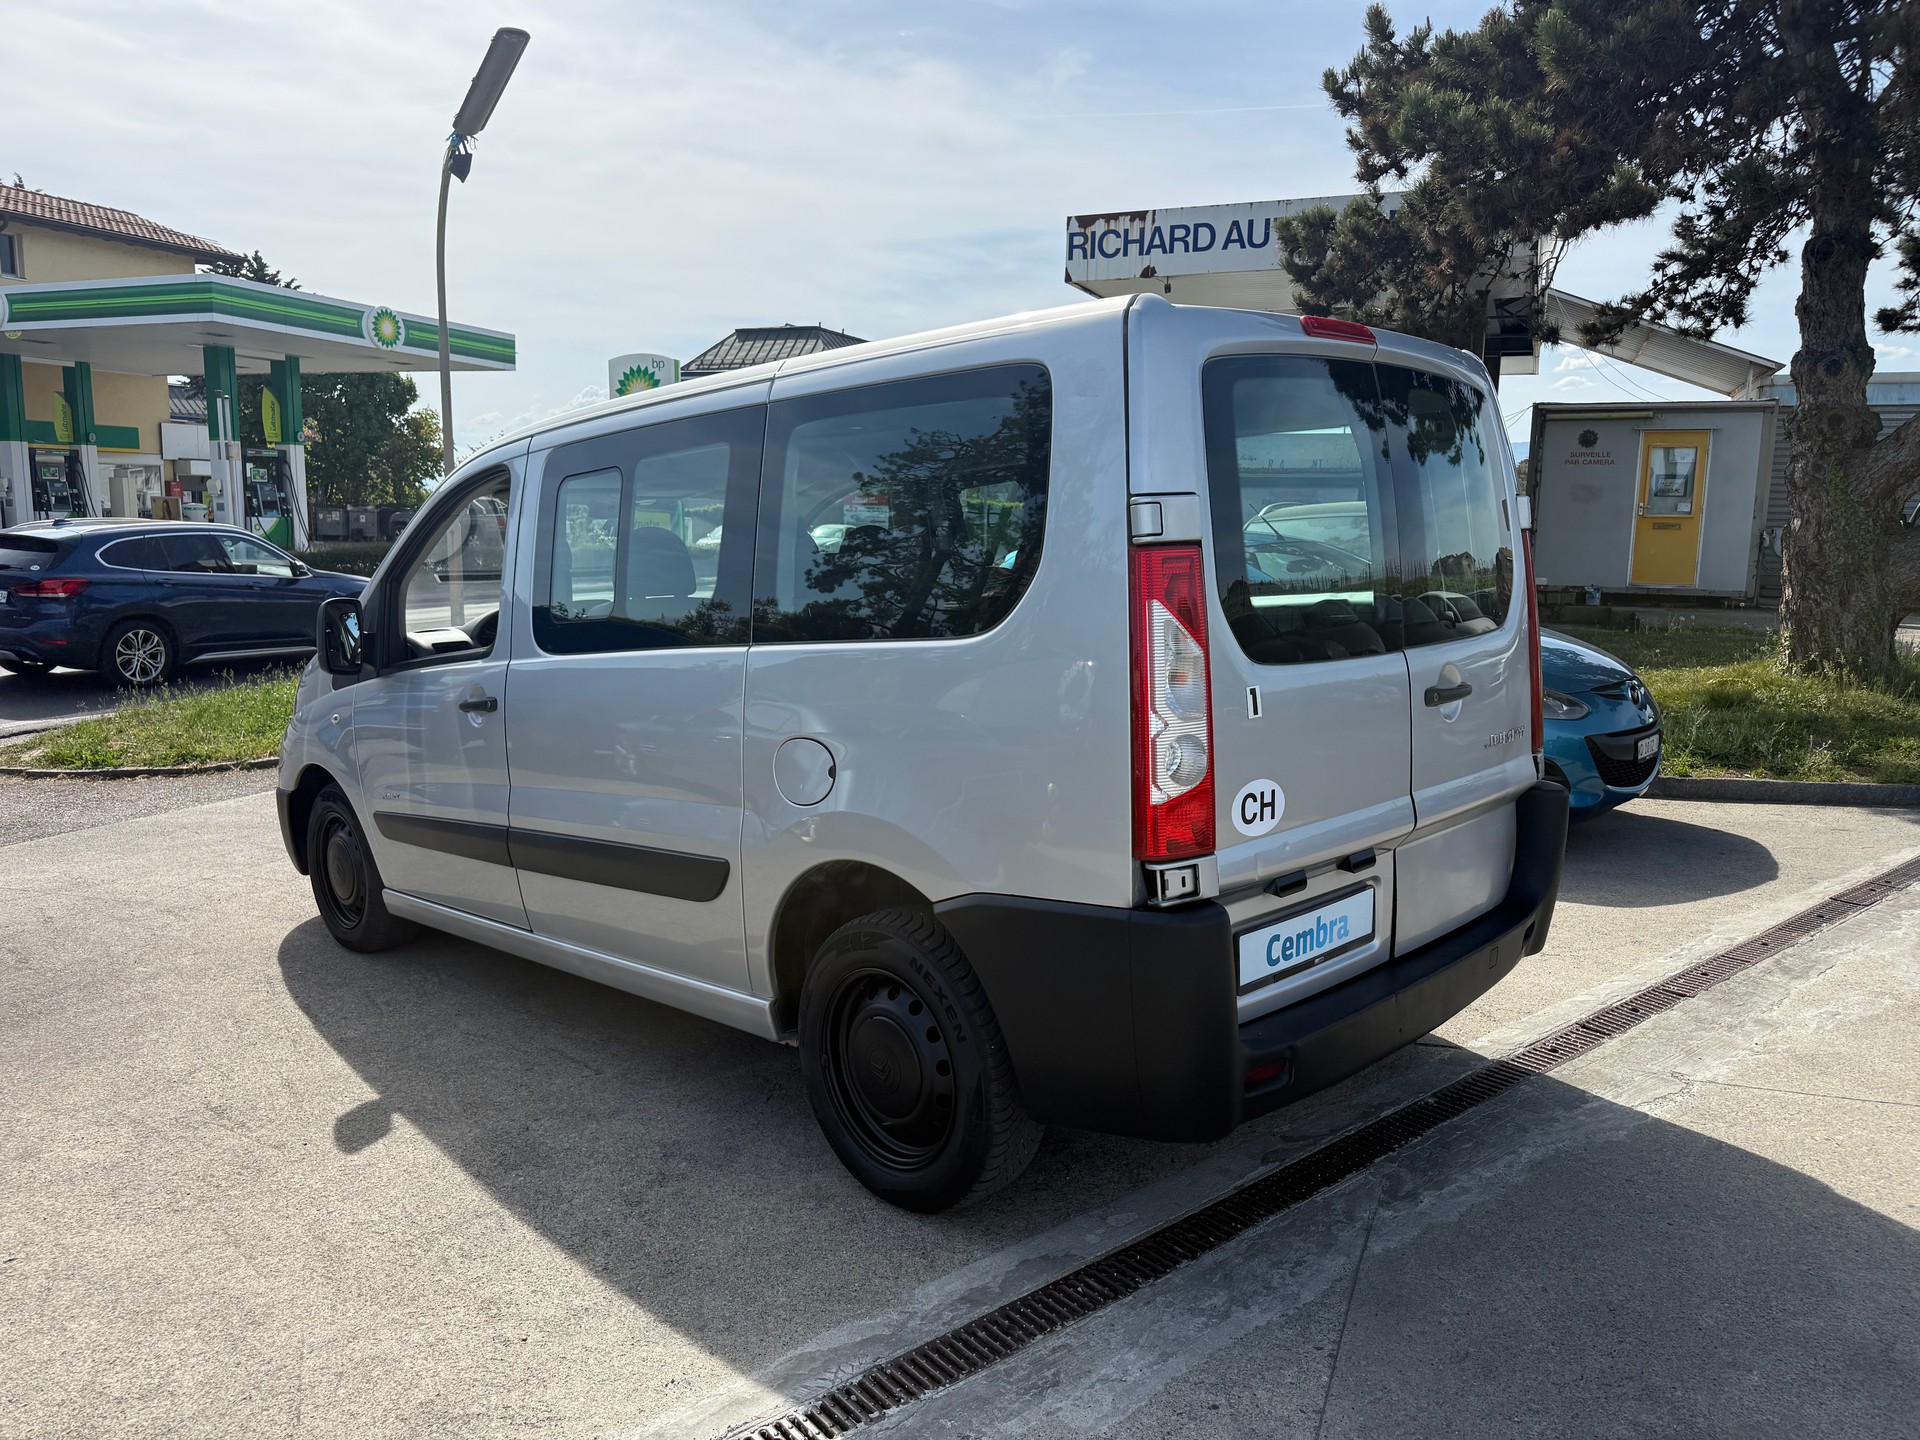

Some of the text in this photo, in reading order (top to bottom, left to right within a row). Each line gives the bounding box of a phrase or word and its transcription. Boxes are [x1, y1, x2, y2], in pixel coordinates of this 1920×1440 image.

[1067, 216, 1278, 261] RICHARD AU
[651, 357, 666, 371] bp
[1240, 788, 1276, 825] CH
[1265, 914, 1350, 967] Cembra
[908, 955, 968, 1045] NEXEN
